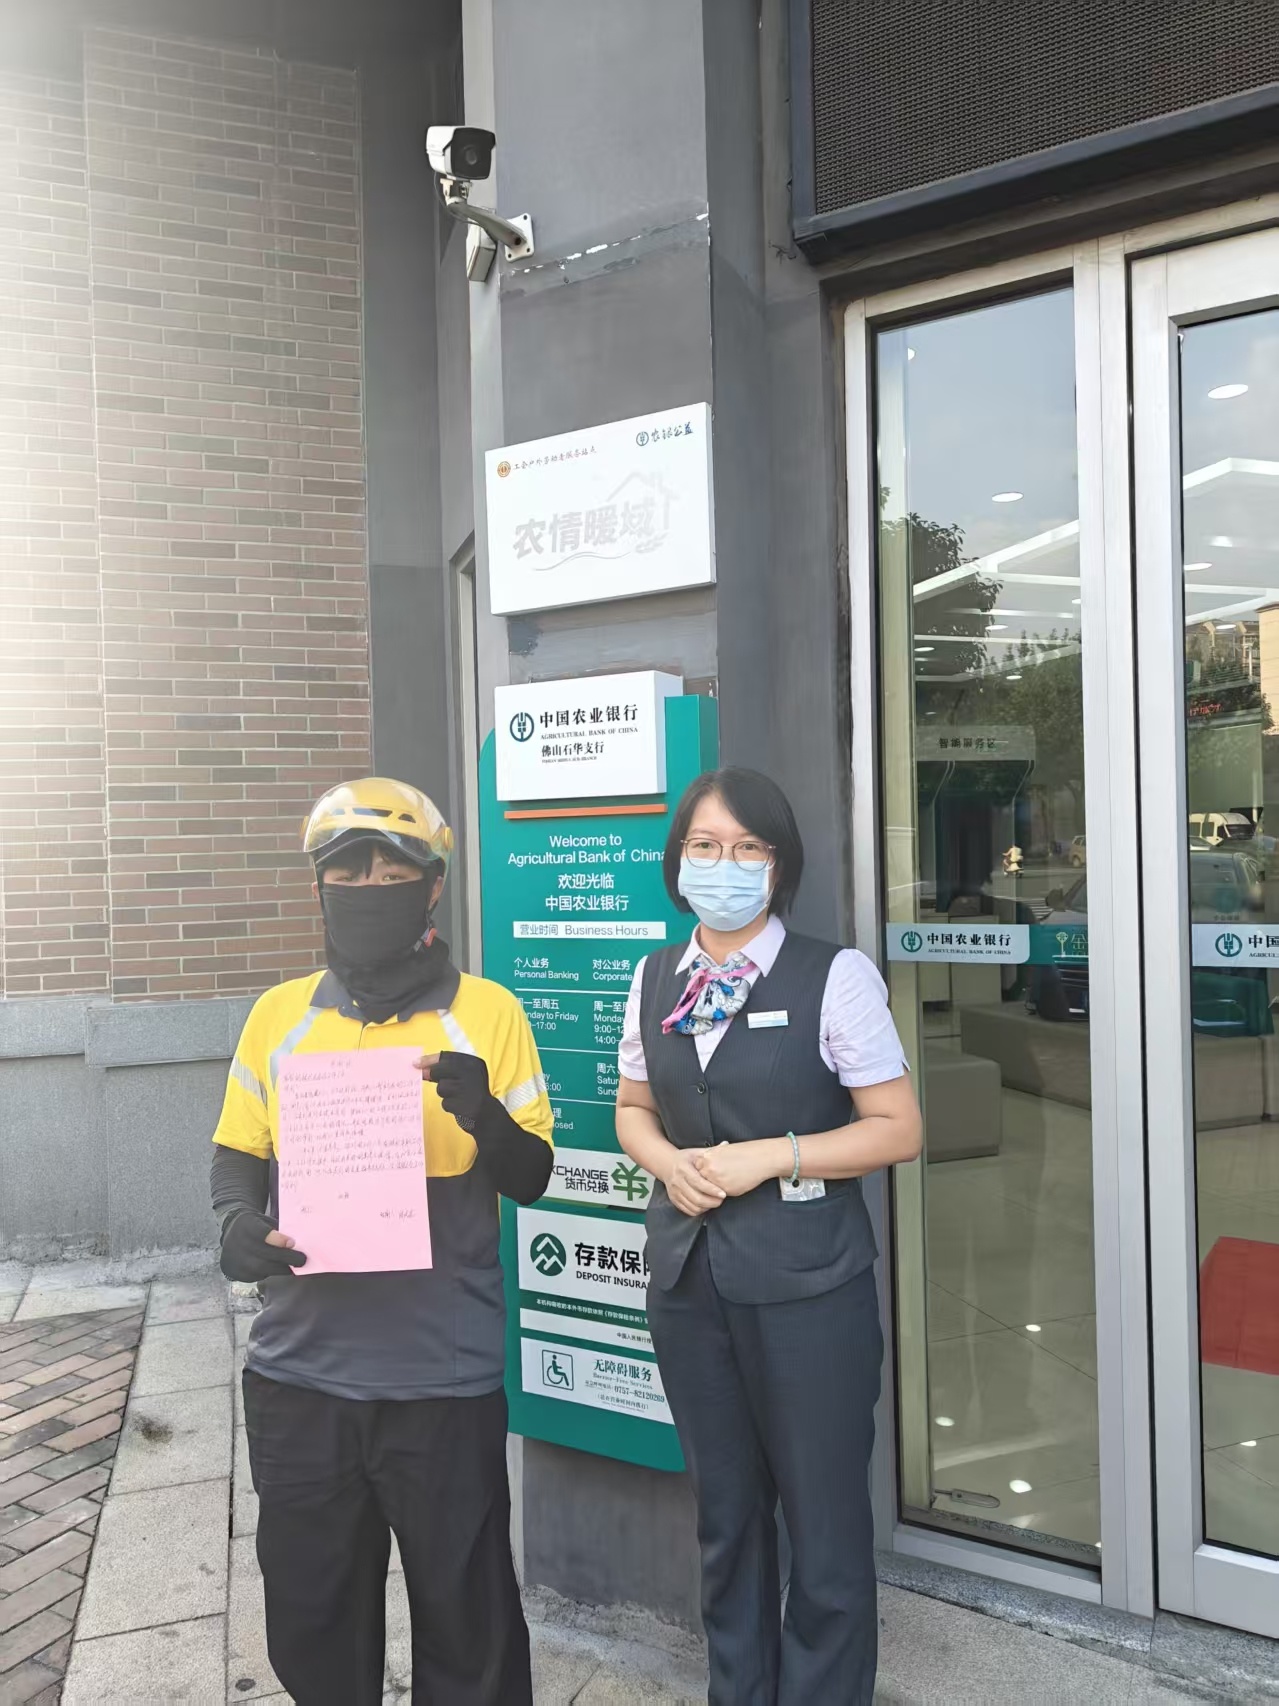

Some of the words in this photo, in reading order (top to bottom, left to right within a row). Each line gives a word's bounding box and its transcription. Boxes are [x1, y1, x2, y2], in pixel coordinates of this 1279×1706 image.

[540, 704, 638, 728] 中国农业银行
[541, 731, 585, 740] AGRICULTURAL
[541, 741, 605, 757] 佛山石华支行
[549, 834, 606, 848] Welcome
[610, 833, 622, 845] to
[508, 851, 575, 867] Agricultural
[579, 849, 610, 863] Bank
[613, 849, 626, 862] of
[558, 873, 614, 889] 欢迎光临
[545, 895, 629, 911] 中国农业银行
[520, 924, 558, 936] 营业时间
[565, 925, 612, 936] Business
[615, 925, 648, 936] Hours
[927, 932, 1012, 948] 中国农业银行
[514, 957, 549, 968] 个人业务
[593, 959, 631, 970] 对公业务
[514, 970, 546, 979] Personal
[548, 971, 579, 981] Banking
[593, 972, 633, 982] Corporate
[526, 1011, 545, 1020] nday
[555, 1013, 579, 1022] Friday
[554, 1121, 574, 1130] osed
[565, 1177, 610, 1195] 货币兑换
[576, 1271, 611, 1285] DEPOSIT
[593, 1358, 653, 1383] 无障碍服务
